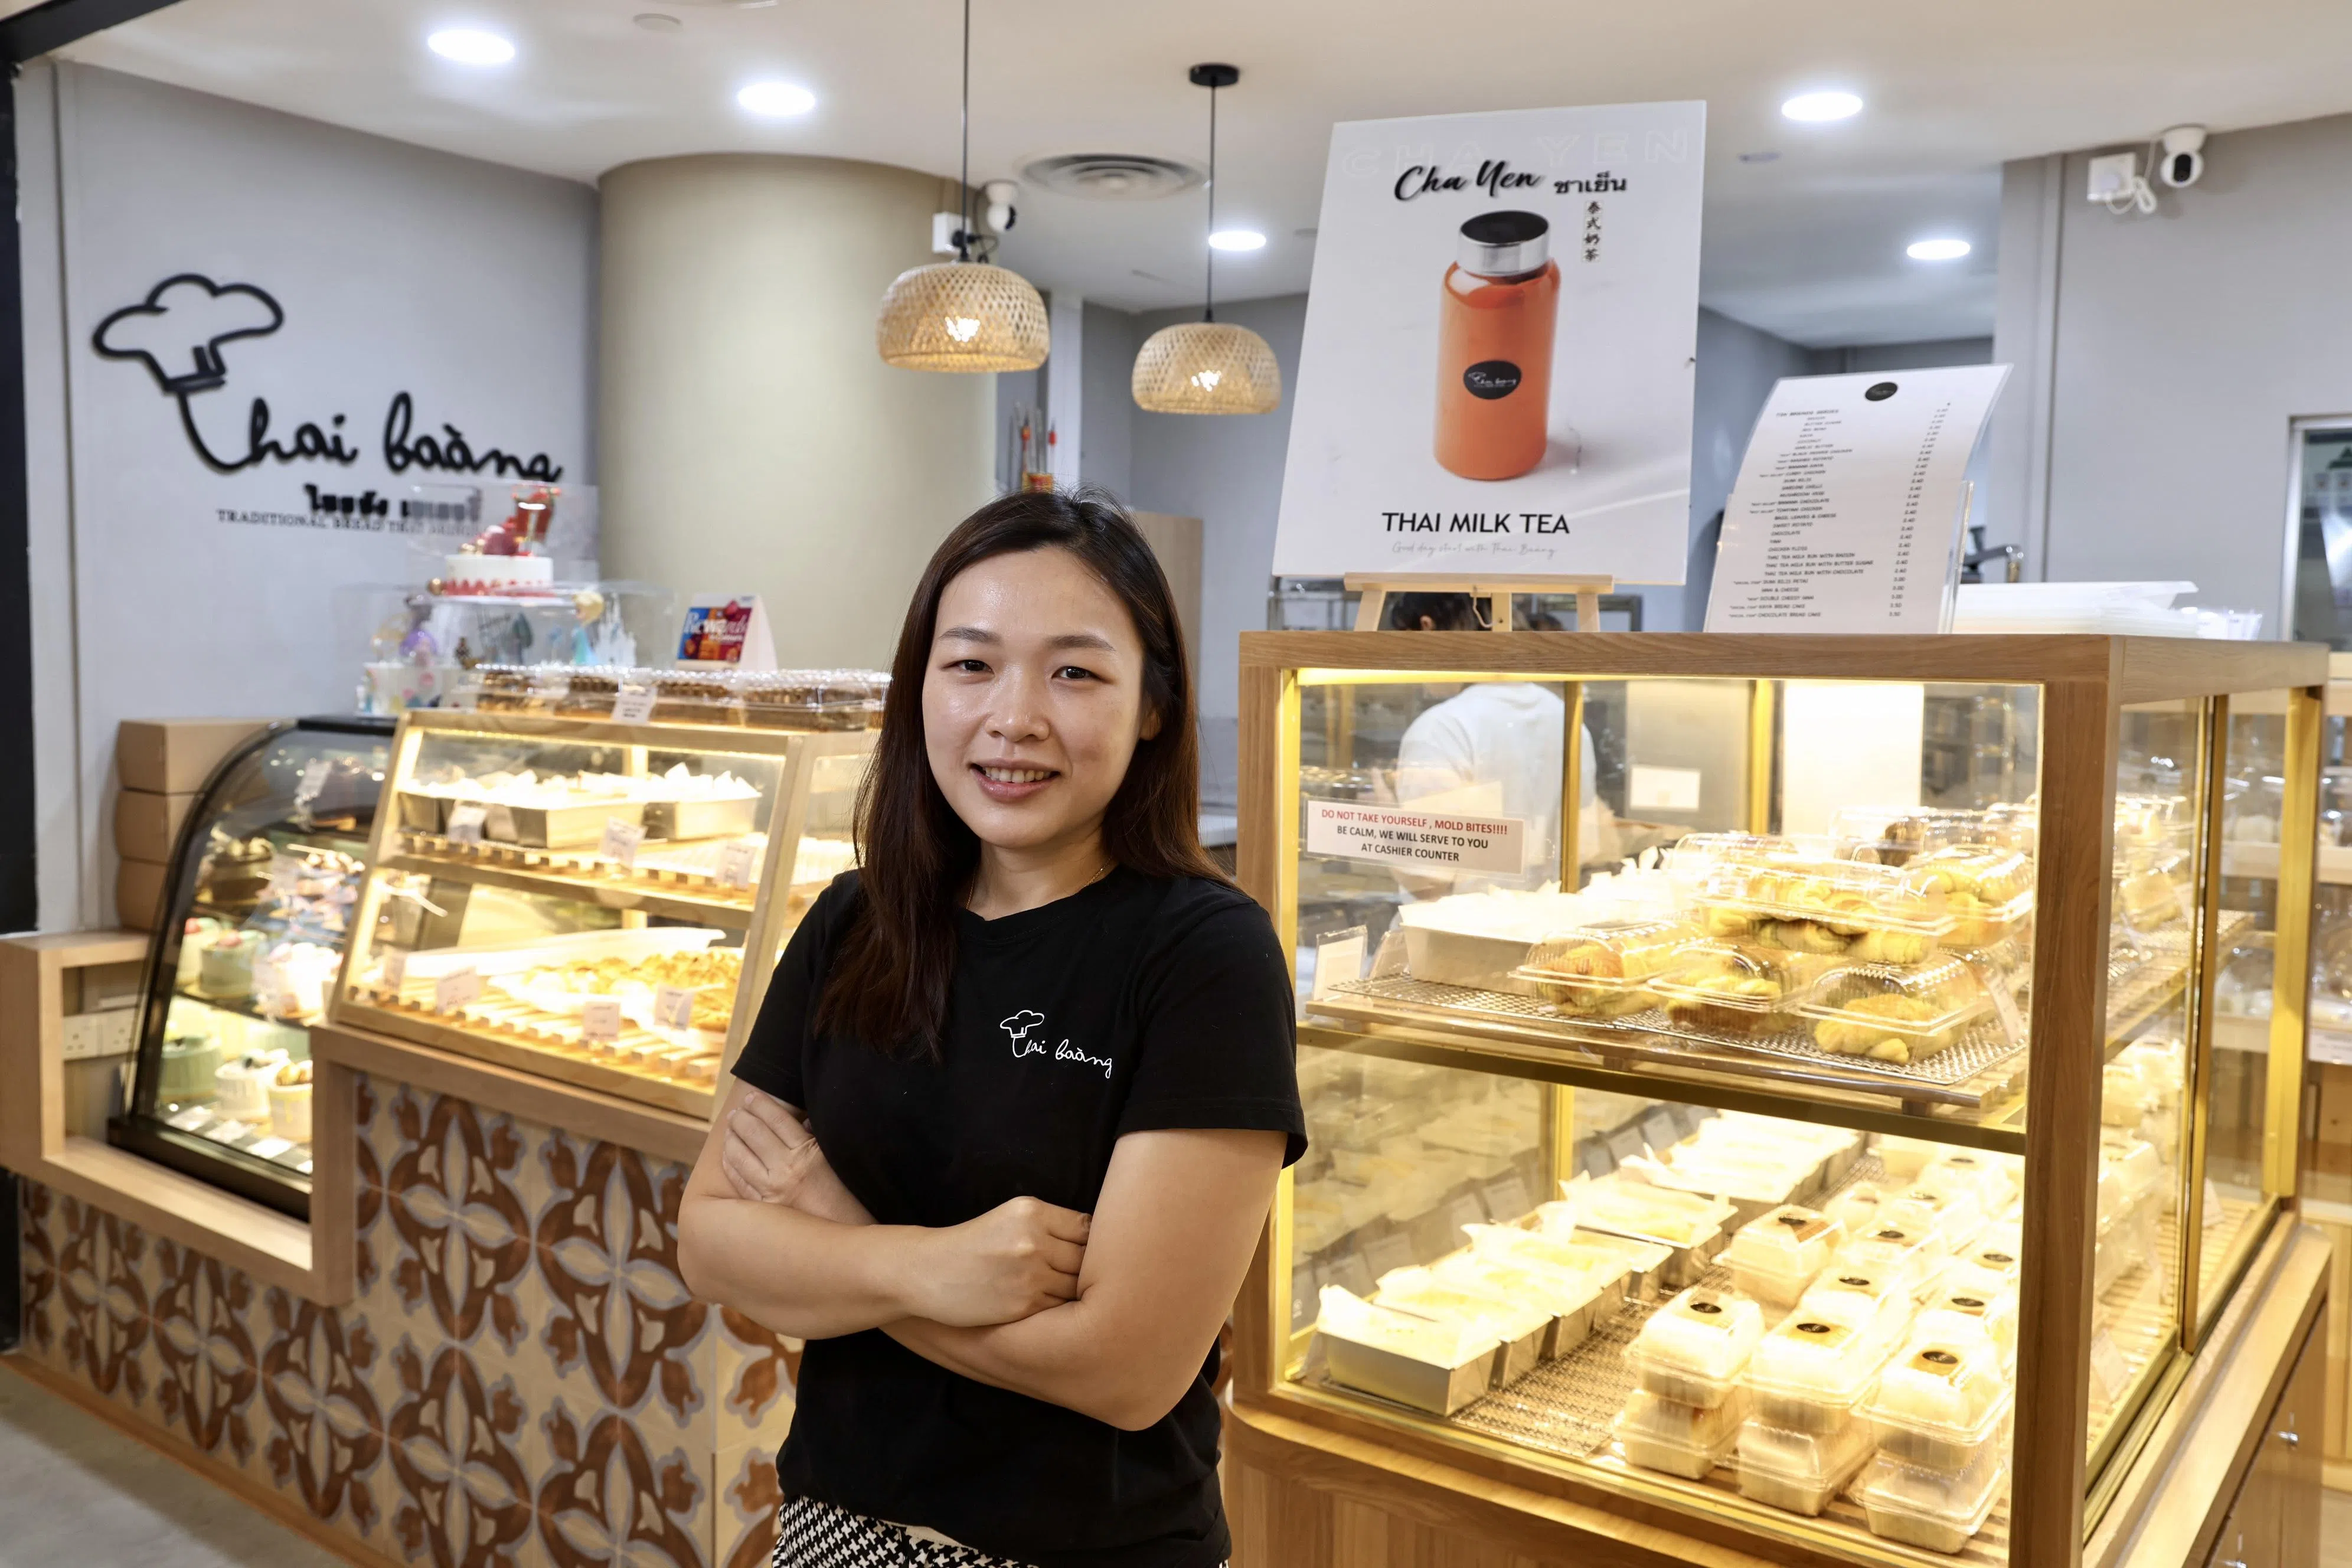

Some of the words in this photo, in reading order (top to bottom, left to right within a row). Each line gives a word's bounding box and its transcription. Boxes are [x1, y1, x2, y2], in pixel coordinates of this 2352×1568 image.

[1536, 129, 1687, 168] YEN
[1394, 165, 1468, 201] Cha
[1476, 159, 1541, 197] Yen
[1554, 171, 1626, 194] ชาเย็น
[216, 509, 326, 529] TRADITIONAL
[1382, 512, 1440, 532] THAI
[1449, 512, 1510, 533] MILK
[1520, 514, 1570, 534] TEA
[1321, 809, 1334, 819] DO
[1337, 811, 1355, 821] NOT
[1357, 812, 1378, 823] TAKE
[1381, 815, 1427, 827] YOURSELF
[1435, 819, 1464, 831] MOLD
[1466, 822, 1508, 835] BITES!!!!
[1337, 825, 1348, 835] BE
[1350, 827, 1377, 839] CALM,
[1379, 829, 1394, 840] WE
[1396, 831, 1418, 842] WILL
[1420, 834, 1450, 846] SERVE
[1452, 837, 1465, 847] TO
[1467, 838, 1488, 849] YOU
[1361, 843, 1373, 852] AT
[1374, 844, 1413, 857] CASHIER
[1415, 848, 1460, 862] COUNTER
